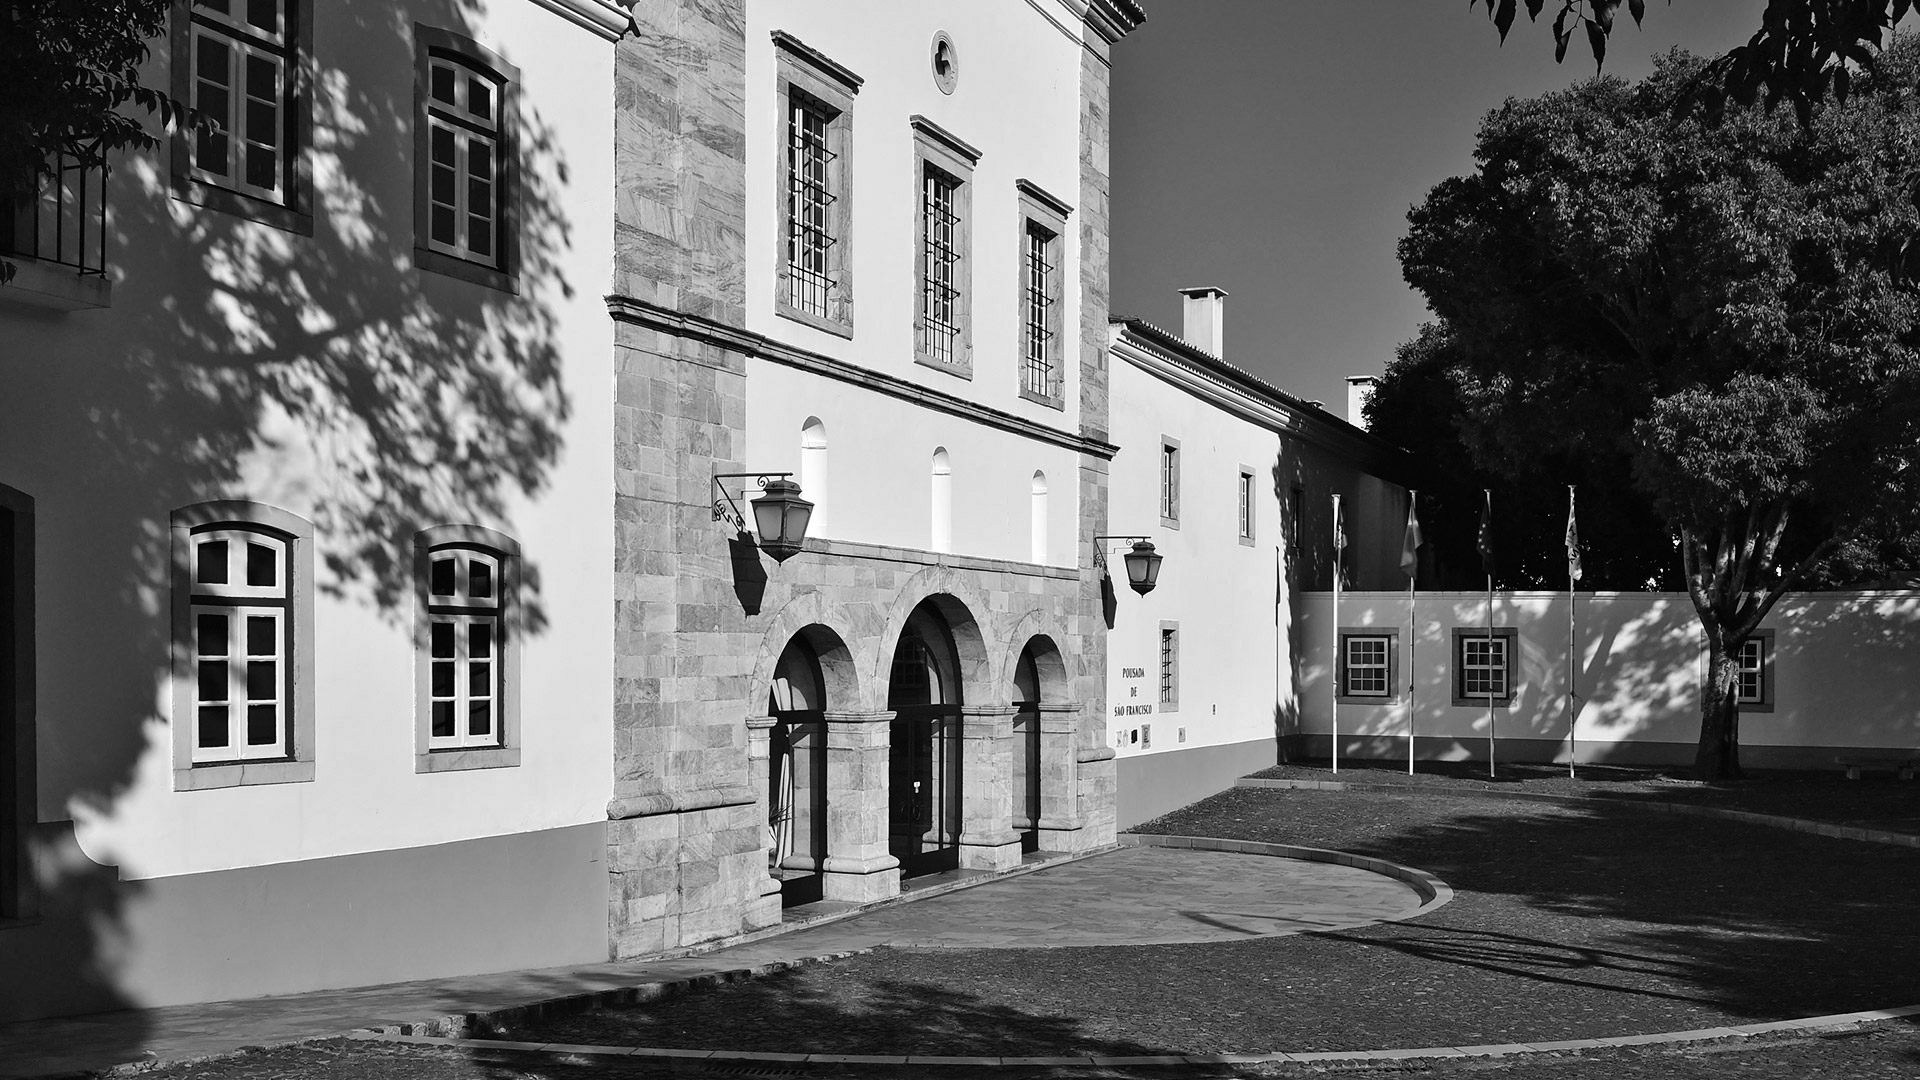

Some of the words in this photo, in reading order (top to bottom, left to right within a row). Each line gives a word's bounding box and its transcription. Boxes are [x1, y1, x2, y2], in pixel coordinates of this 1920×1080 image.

[1122, 668, 1144, 678] POUSADA
[1130, 687, 1137, 697] DE
[1126, 704, 1152, 716] FRANCISCO
